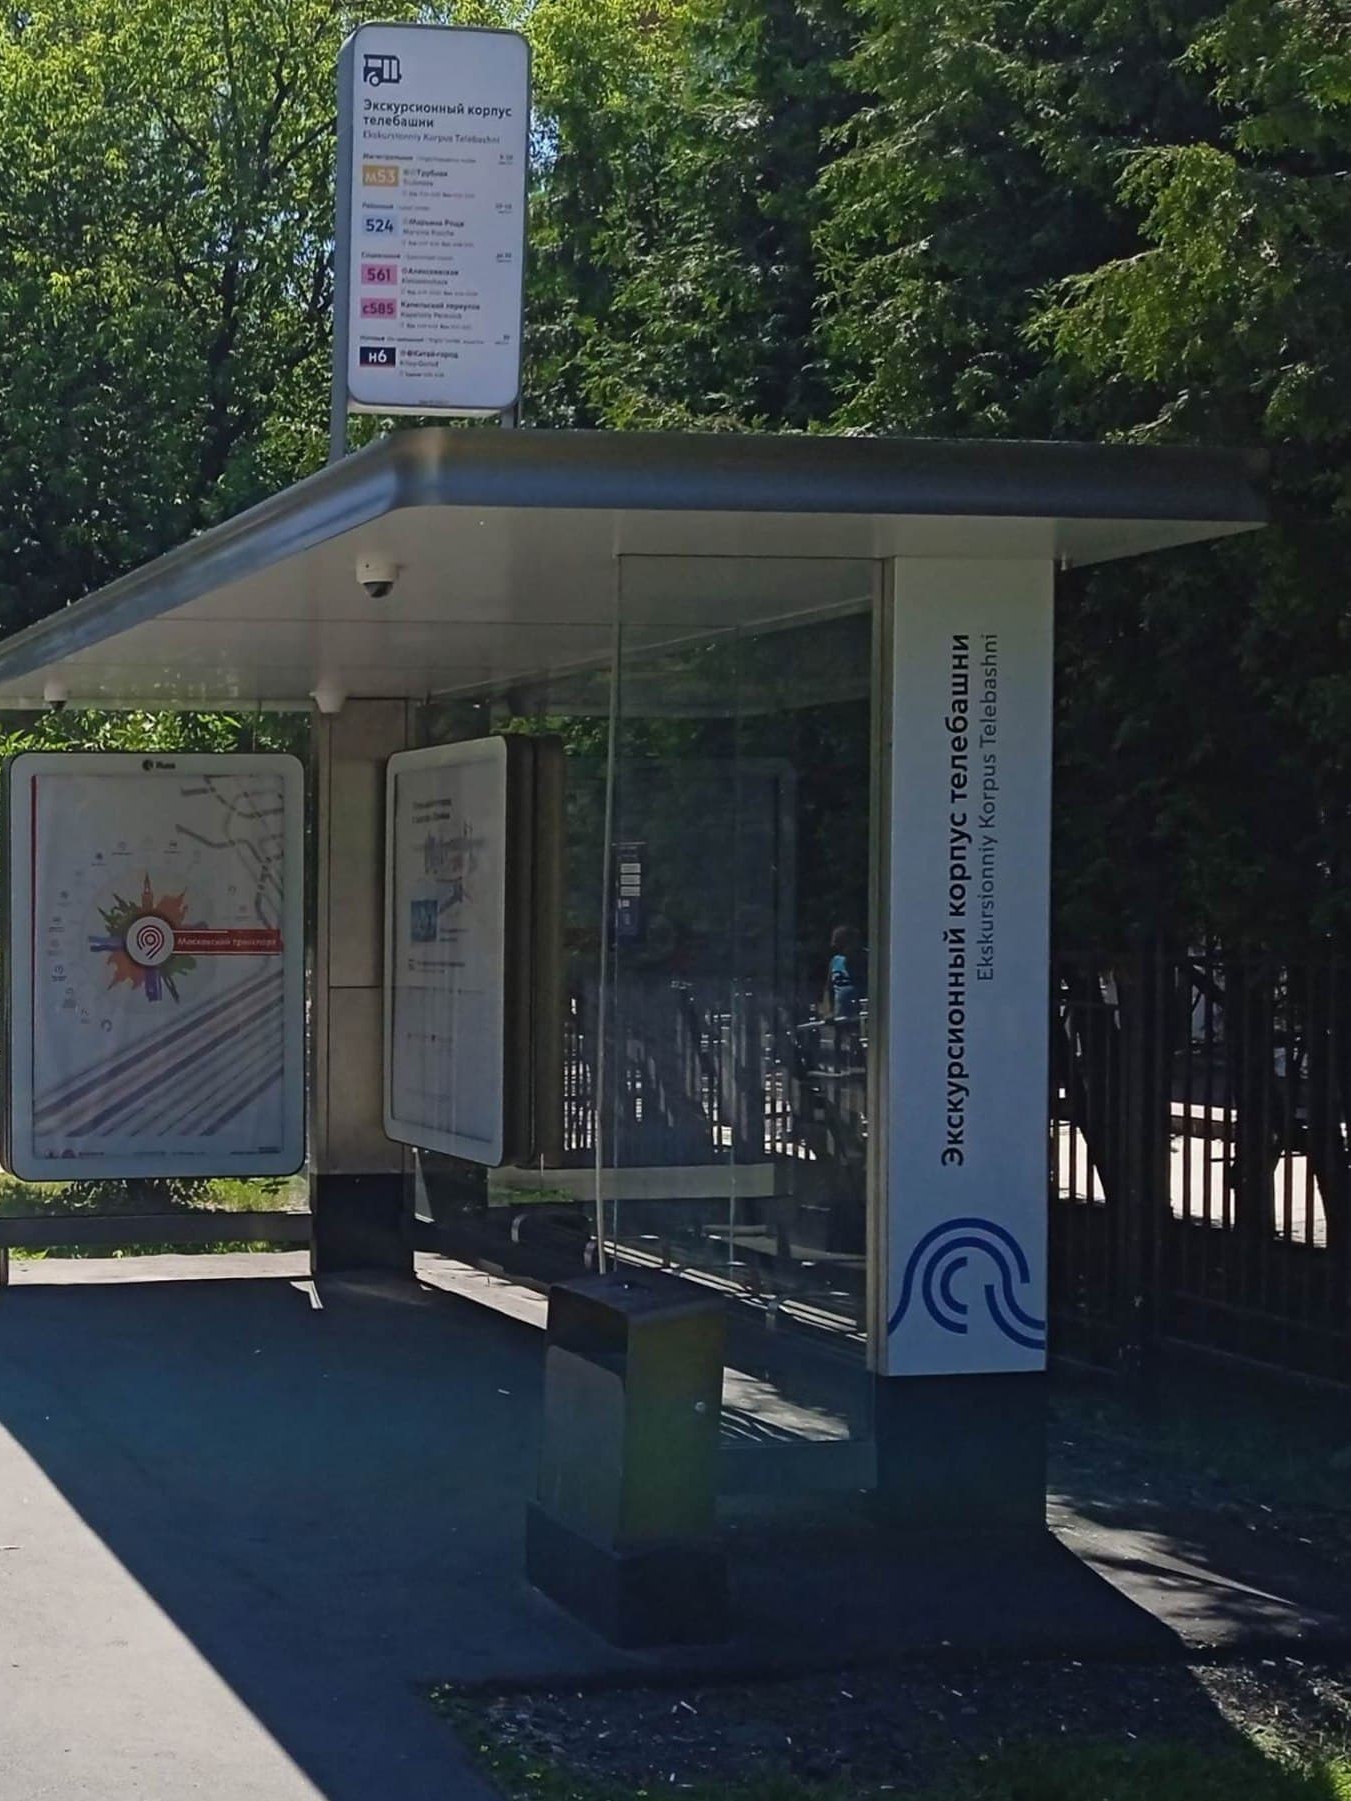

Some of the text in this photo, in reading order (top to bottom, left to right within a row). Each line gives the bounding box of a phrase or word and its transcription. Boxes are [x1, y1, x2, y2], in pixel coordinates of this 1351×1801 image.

[363, 99, 512, 119] Экскурсионный корпус
[363, 114, 434, 127] телебашни
[365, 218, 394, 233] 524
[367, 267, 391, 282] 561
[977, 634, 999, 981] Ekskursionniy Korpus Telebashni
[941, 634, 972, 1167] Экскурсионный корпус телебашни
